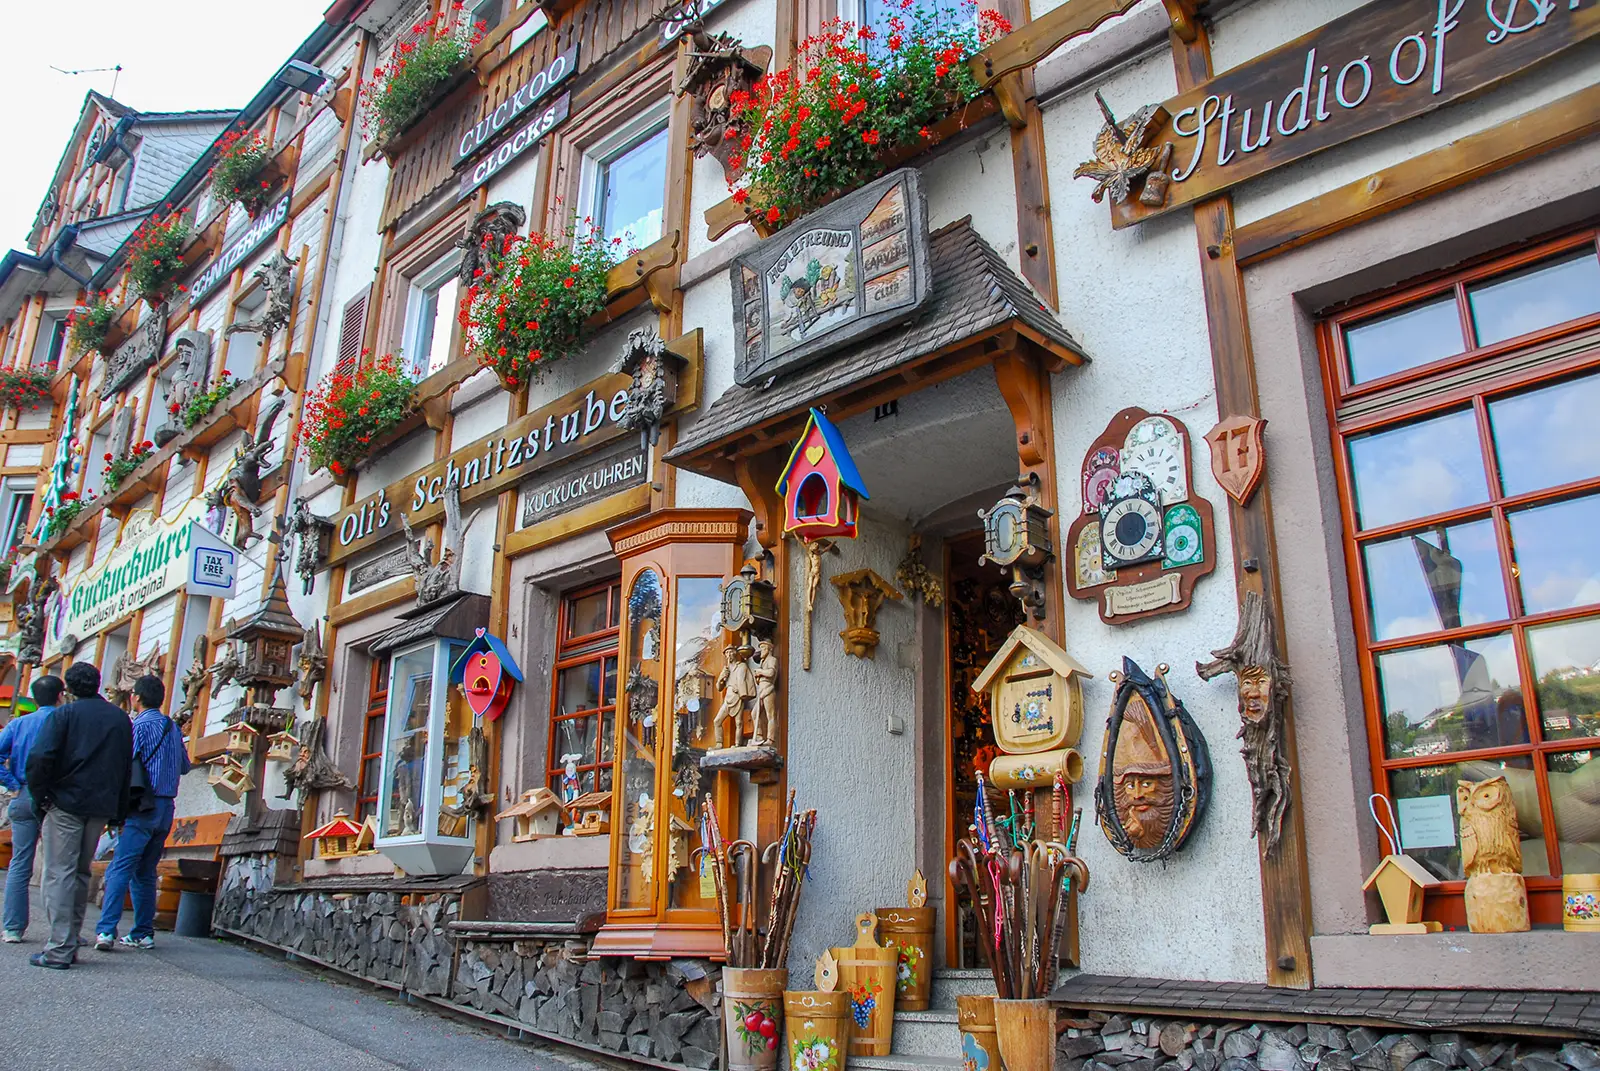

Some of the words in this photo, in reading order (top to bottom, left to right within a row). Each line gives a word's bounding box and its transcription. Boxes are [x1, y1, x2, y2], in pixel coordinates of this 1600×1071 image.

[459, 56, 566, 158] CUCKOO
[1171, 48, 1372, 182] Studio
[1389, 0, 1466, 95] of
[472, 106, 556, 184] CLOCKS
[190, 195, 289, 305] SCHNITZERHAUS
[873, 281, 900, 301] CLUB
[339, 488, 390, 546] Oli's
[412, 389, 629, 511] Schnitzstube
[1214, 425, 1251, 474] 17
[524, 454, 643, 516] KUCKUCK-UHREN
[203, 563, 224, 575] FREE
[206, 555, 223, 565] TAX
[82, 600, 117, 632] exclusiv
[118, 594, 126, 611] &
[127, 568, 167, 605] original
